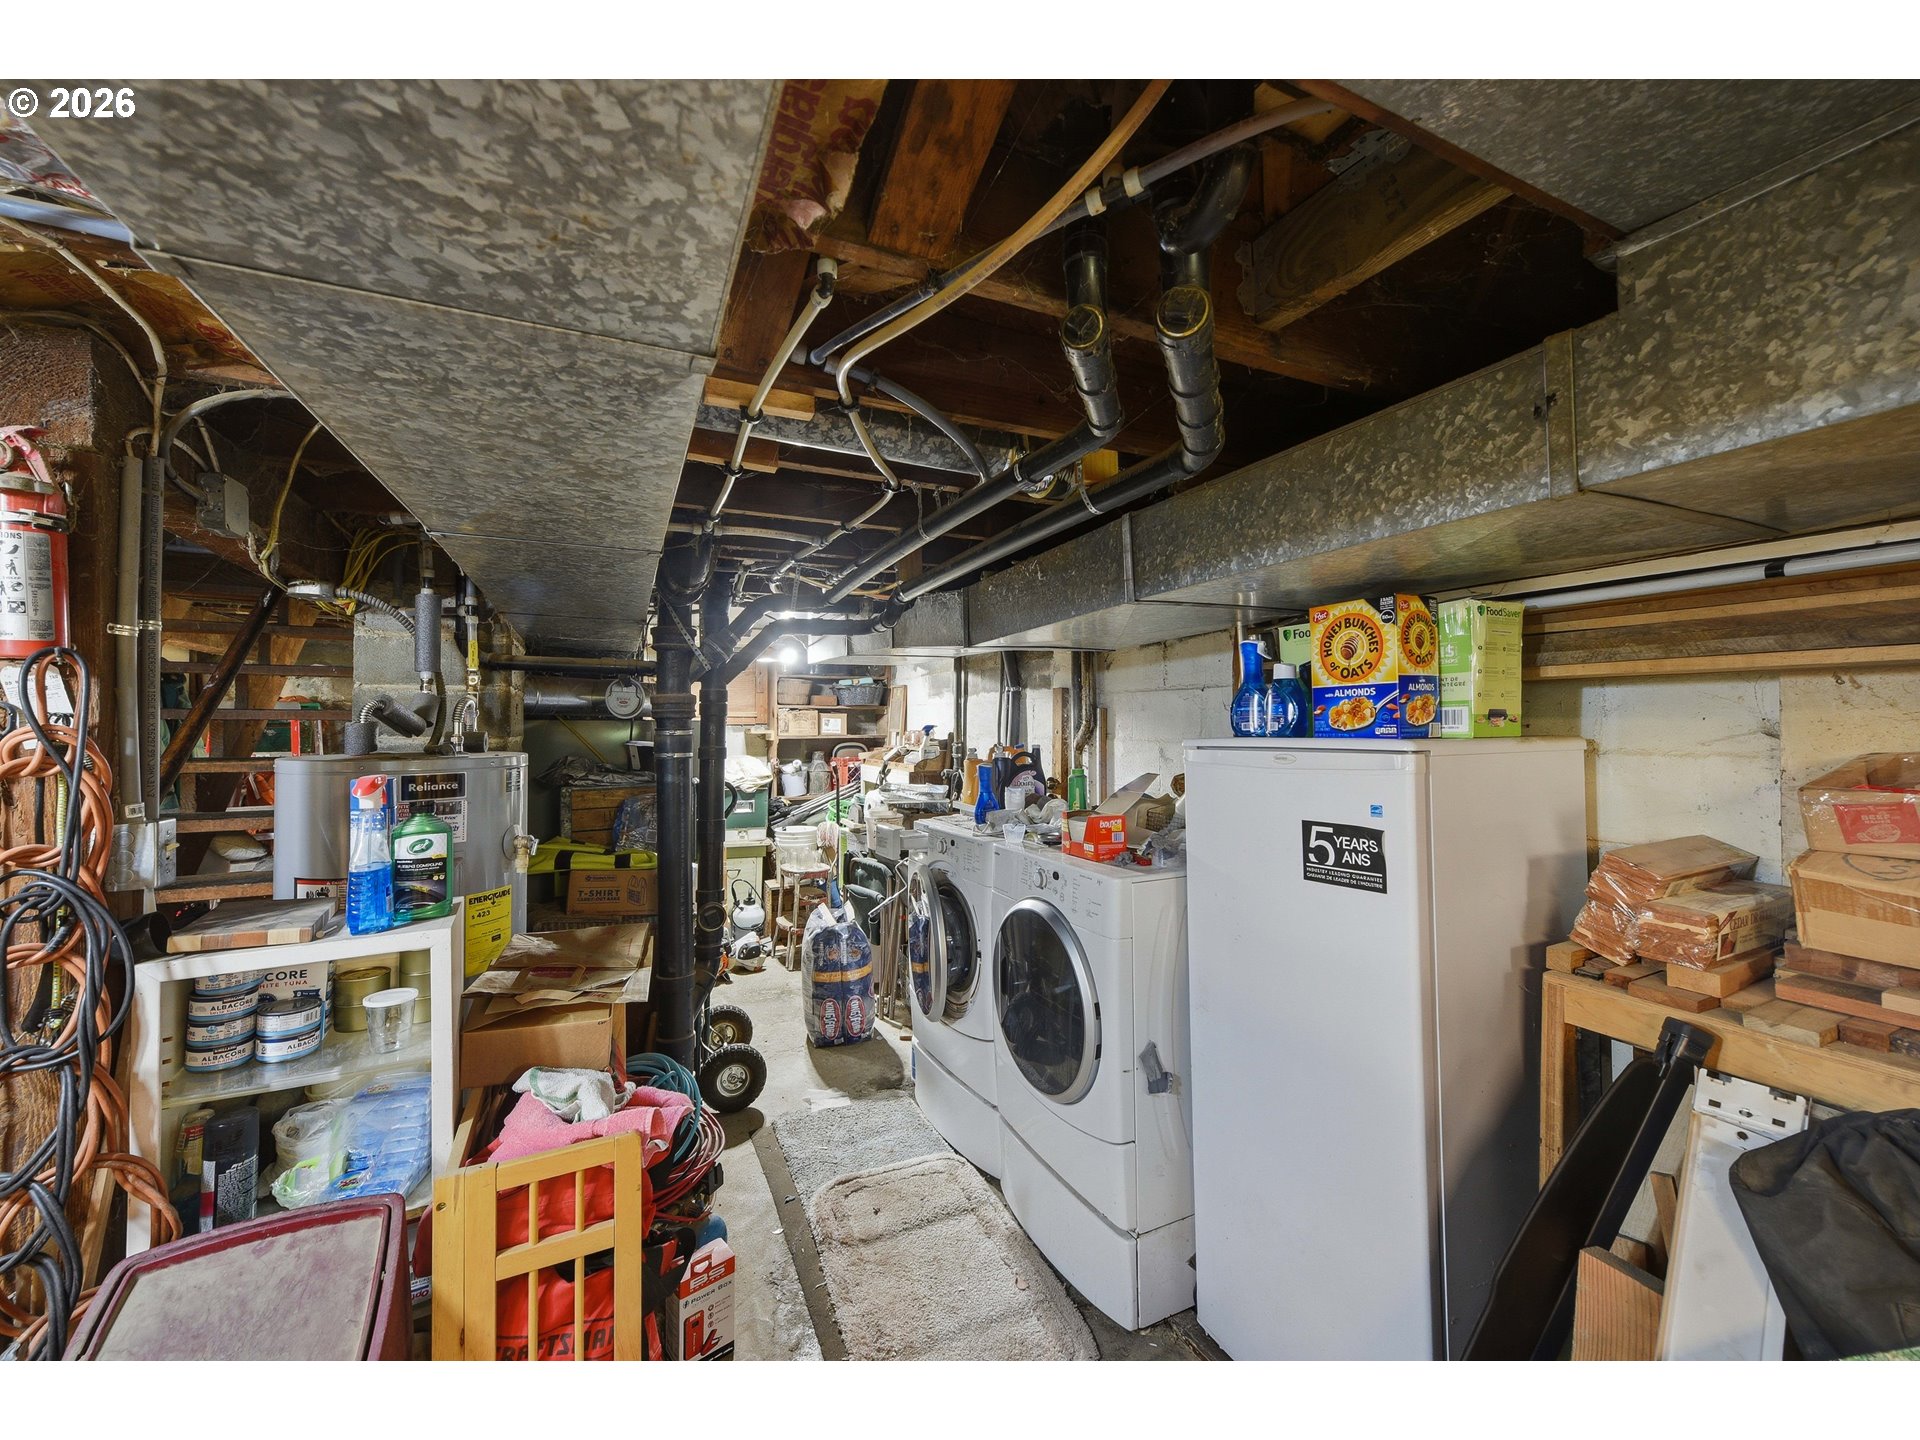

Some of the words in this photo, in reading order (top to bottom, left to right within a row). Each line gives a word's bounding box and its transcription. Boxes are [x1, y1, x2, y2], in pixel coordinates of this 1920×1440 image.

[149, 558, 158, 586] CONDUIT
[1486, 606, 1521, 618] FoodSaver
[1403, 613, 1416, 645] HONEY
[1323, 620, 1343, 658] HONEY
[1344, 617, 1379, 653] BUNCHES
[1415, 650, 1433, 665] OATS
[1329, 661, 1341, 673] of
[1340, 658, 1374, 679] OATS
[1334, 687, 1377, 698] ALMONDS
[1408, 683, 1435, 691] ALMONDS
[408, 781, 459, 793] Reliance
[1308, 825, 1336, 866] 5
[1333, 835, 1379, 854] YEARS
[1341, 850, 1371, 867] ANS
[578, 889, 621, 897] T-SHIRT
[476, 909, 491, 919] 423
[209, 997, 253, 1012] ALBACORE
[201, 1048, 247, 1062] ALBACORE
